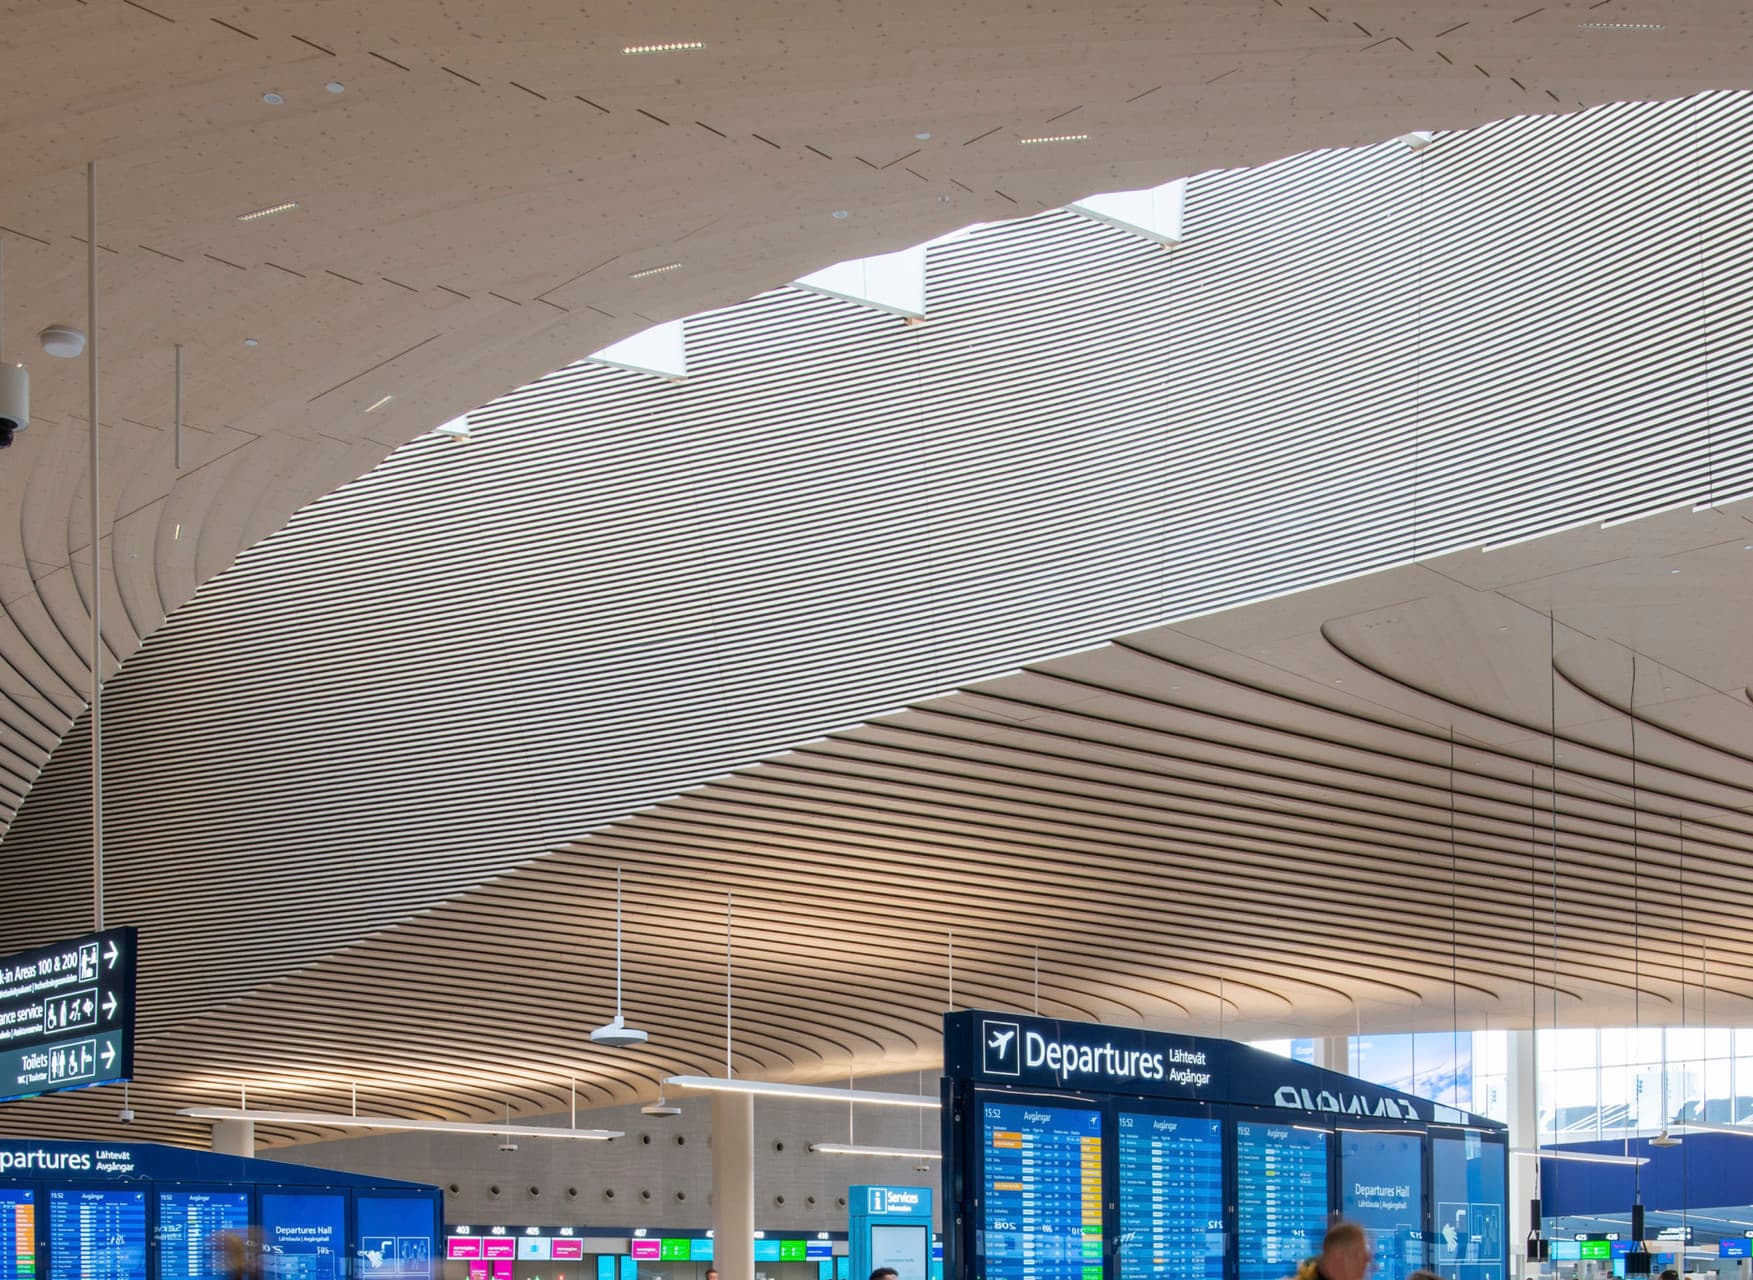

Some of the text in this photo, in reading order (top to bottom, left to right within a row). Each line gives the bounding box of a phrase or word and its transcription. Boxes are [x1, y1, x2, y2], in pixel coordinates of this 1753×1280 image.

[14, 965, 37, 982] Areas
[38, 958, 52, 976] 100
[53, 957, 61, 972] &
[62, 951, 78, 970] 200
[17, 1003, 44, 1022] service
[22, 1053, 48, 1071] Toilets
[1025, 1031, 1164, 1080] Departures
[1169, 1048, 1207, 1066] Lähtevät
[1169, 1067, 1211, 1087] Avgångar
[984, 1108, 1052, 1124] 15:52 Avgångar
[1119, 1117, 1178, 1132] 15:52 Avgångar
[96, 1150, 131, 1161] Lähtevät
[96, 1161, 135, 1173] Avgångar
[1355, 1183, 1411, 1198] Departures Hall
[887, 1191, 919, 1205] Services
[275, 1225, 333, 1235] Departures Hall
[456, 1226, 470, 1235] 403
[491, 1226, 506, 1235] 404
[525, 1226, 540, 1236] 405
[559, 1227, 574, 1236] 406
[634, 1228, 647, 1237] 407
